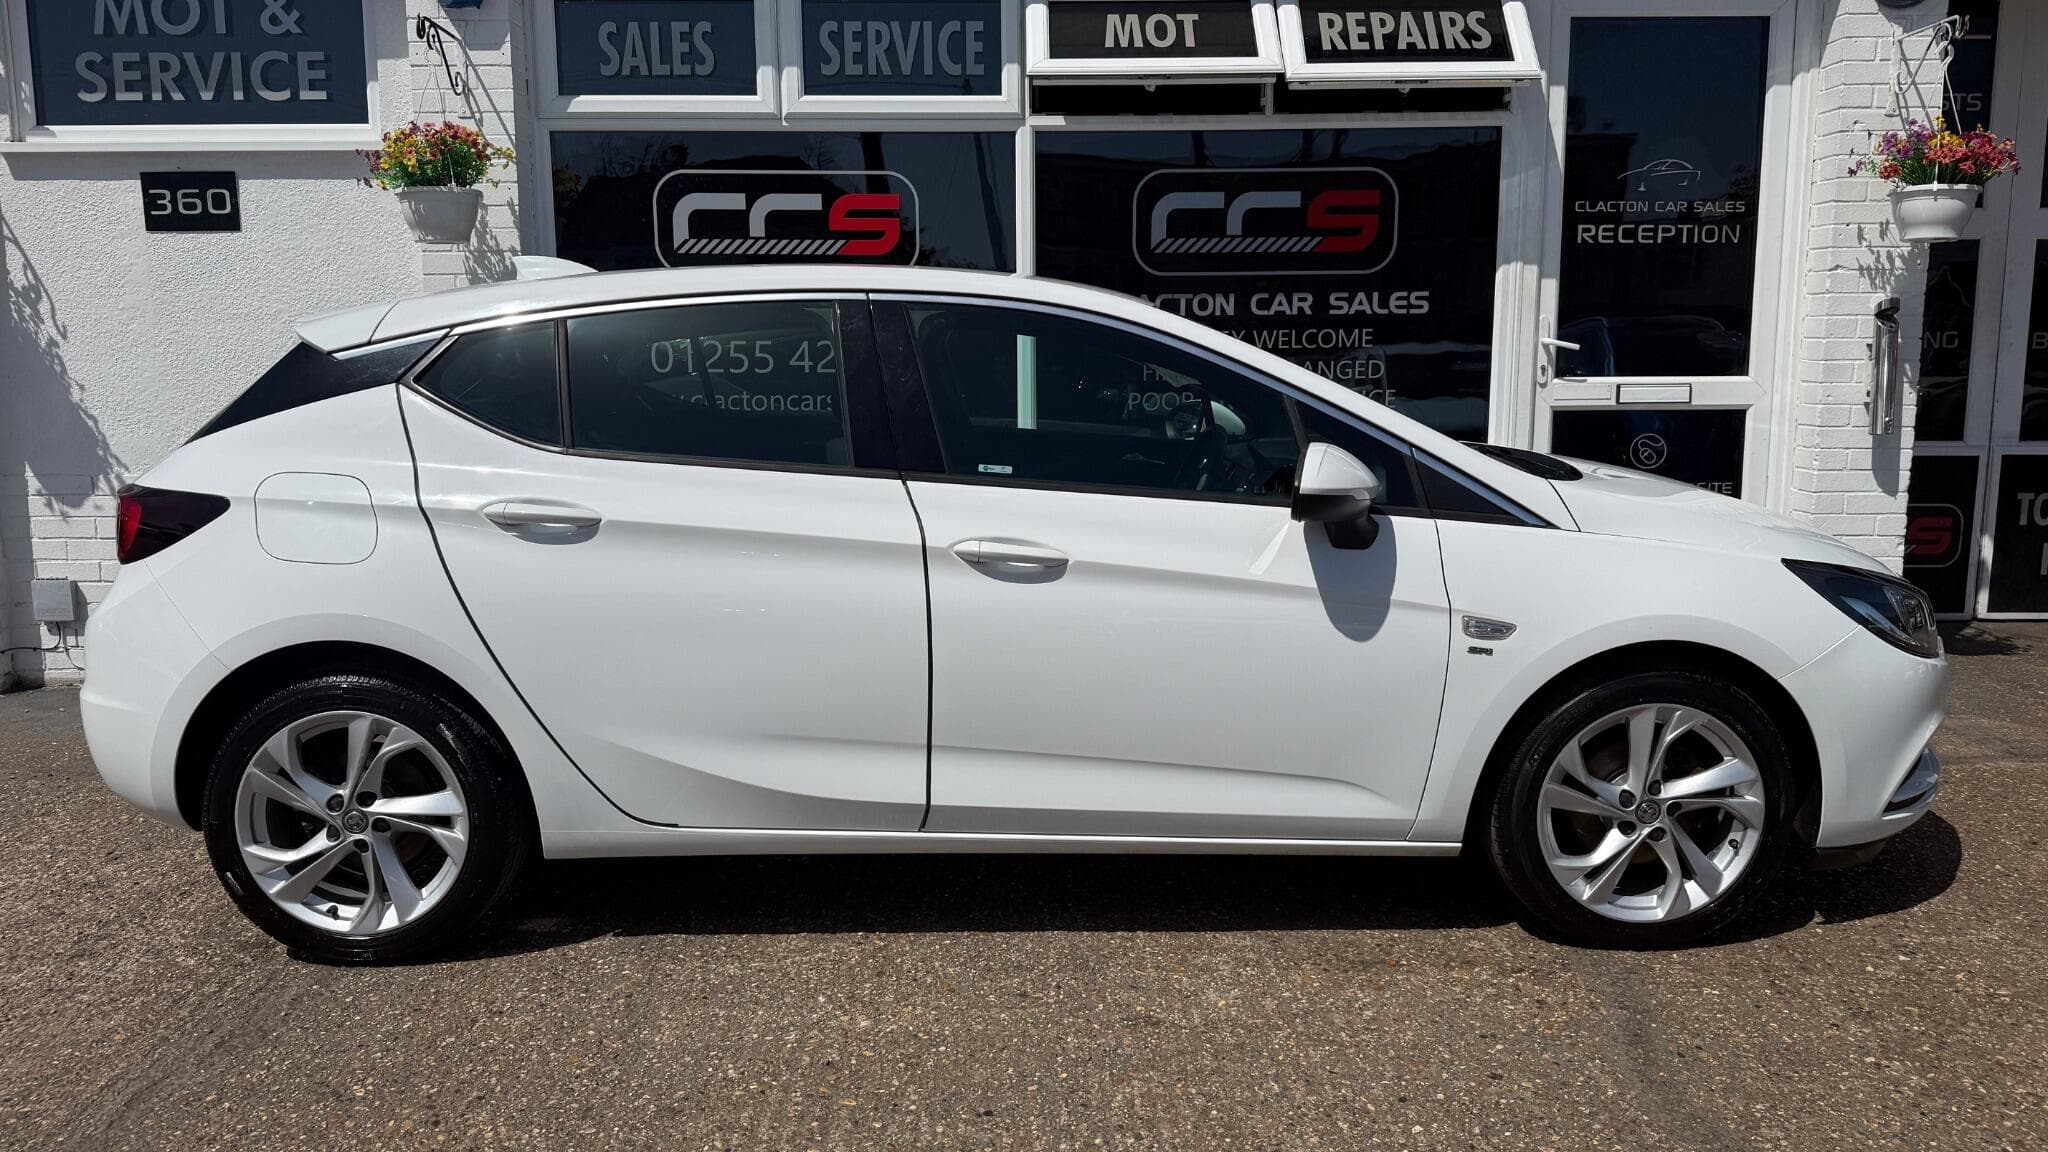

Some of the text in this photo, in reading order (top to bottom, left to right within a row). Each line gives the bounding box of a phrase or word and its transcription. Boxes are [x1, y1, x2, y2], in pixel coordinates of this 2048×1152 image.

[1104, 13, 1199, 48] MOT
[1320, 10, 1493, 51] REPAIRS
[599, 21, 715, 77] SALES
[820, 20, 985, 76] SERVICE
[75, 51, 328, 102] SERVICE
[148, 188, 231, 216] 360
[1575, 201, 1746, 212] CLACTON CAR SALES
[1577, 224, 1740, 244] RECEPTION
[1250, 292, 1312, 315] CAR
[1328, 290, 1430, 315] SALES
[1253, 328, 1374, 349] WELCOME
[650, 340, 775, 374] 01255
